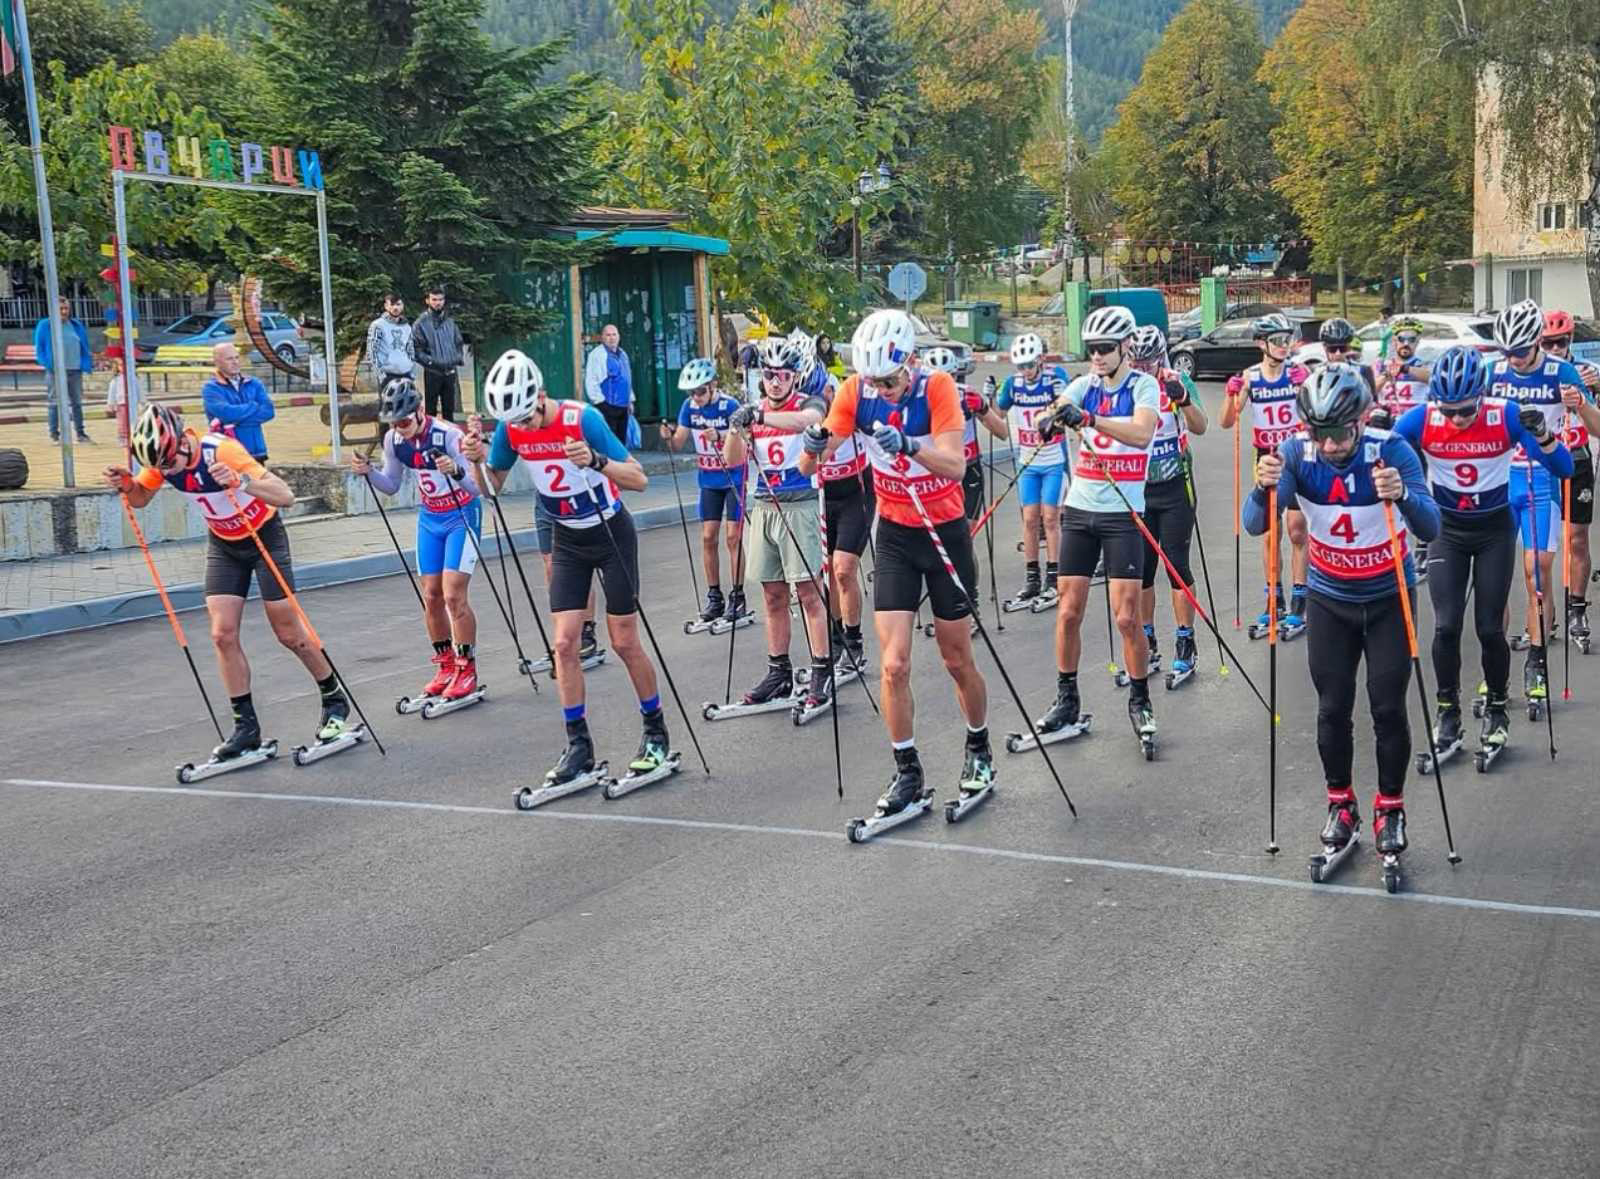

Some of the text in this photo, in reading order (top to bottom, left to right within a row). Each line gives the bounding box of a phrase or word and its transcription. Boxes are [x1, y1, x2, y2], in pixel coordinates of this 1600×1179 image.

[109, 125, 325, 191] ОВЧАРЦИ
[1492, 382, 1555, 399] Fibank
[1263, 404, 1292, 425] 16
[767, 441, 784, 465] 6
[1446, 441, 1503, 453] GENERALI
[420, 473, 436, 494] 5
[544, 464, 571, 492] 2
[1454, 463, 1478, 487] 9
[1328, 473, 1356, 502] A1
[196, 496, 217, 515] 1
[1330, 513, 1359, 543] 4
